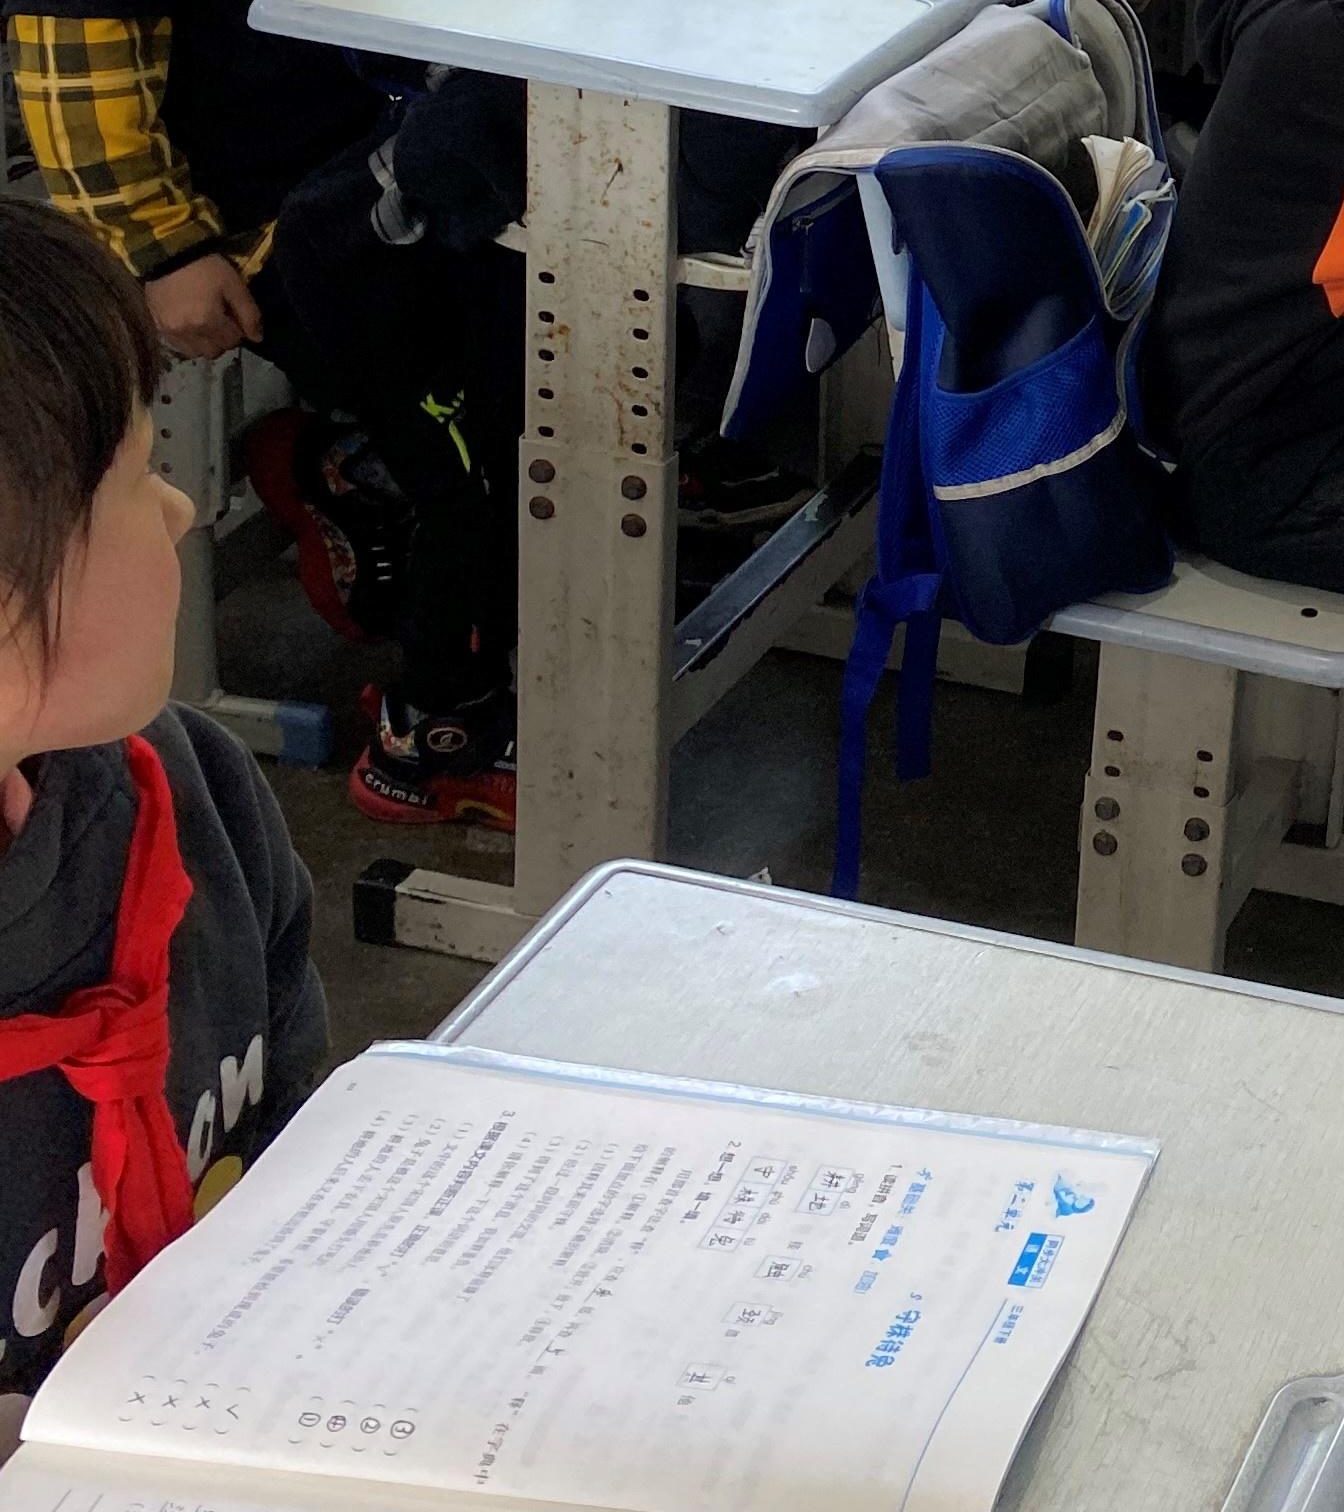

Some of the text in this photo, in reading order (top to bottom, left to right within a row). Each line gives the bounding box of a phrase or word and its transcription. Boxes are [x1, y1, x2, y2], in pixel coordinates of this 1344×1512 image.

[994, 1181, 1035, 1233] 第二单元
[863, 1308, 923, 1368] 守株待兔
